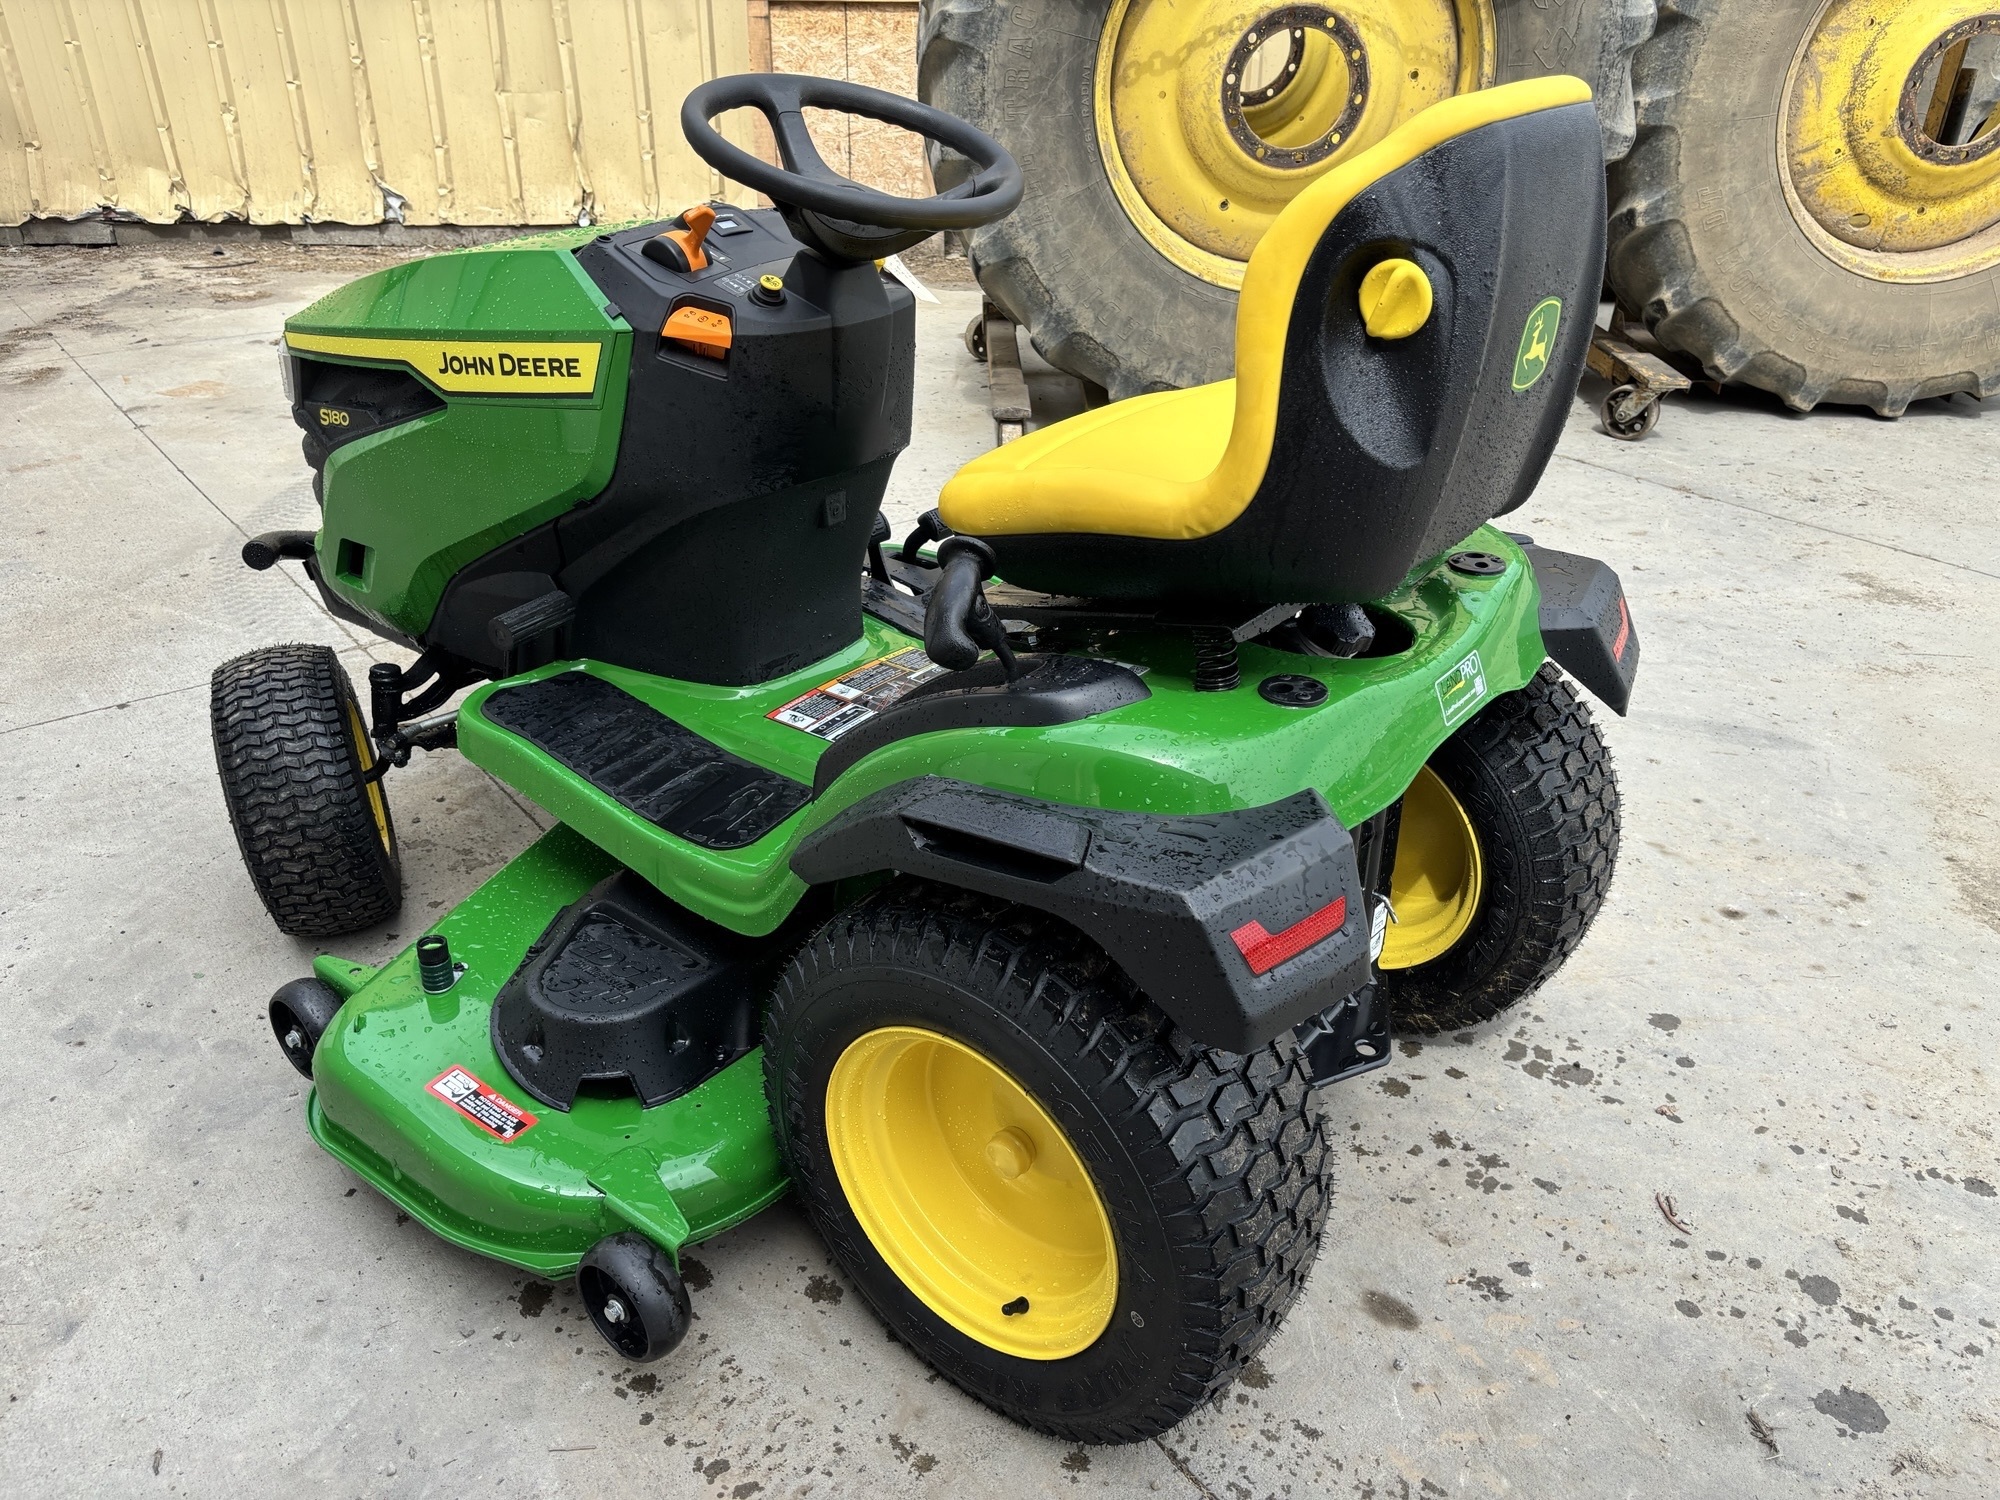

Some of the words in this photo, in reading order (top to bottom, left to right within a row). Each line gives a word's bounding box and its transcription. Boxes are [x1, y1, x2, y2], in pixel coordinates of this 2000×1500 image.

[1080, 60, 1092, 118] RADIAL
[438, 352, 495, 376] JOHN
[498, 353, 582, 378] DEERE
[319, 408, 350, 427] S180
[495, 1097, 524, 1116] DANGER
